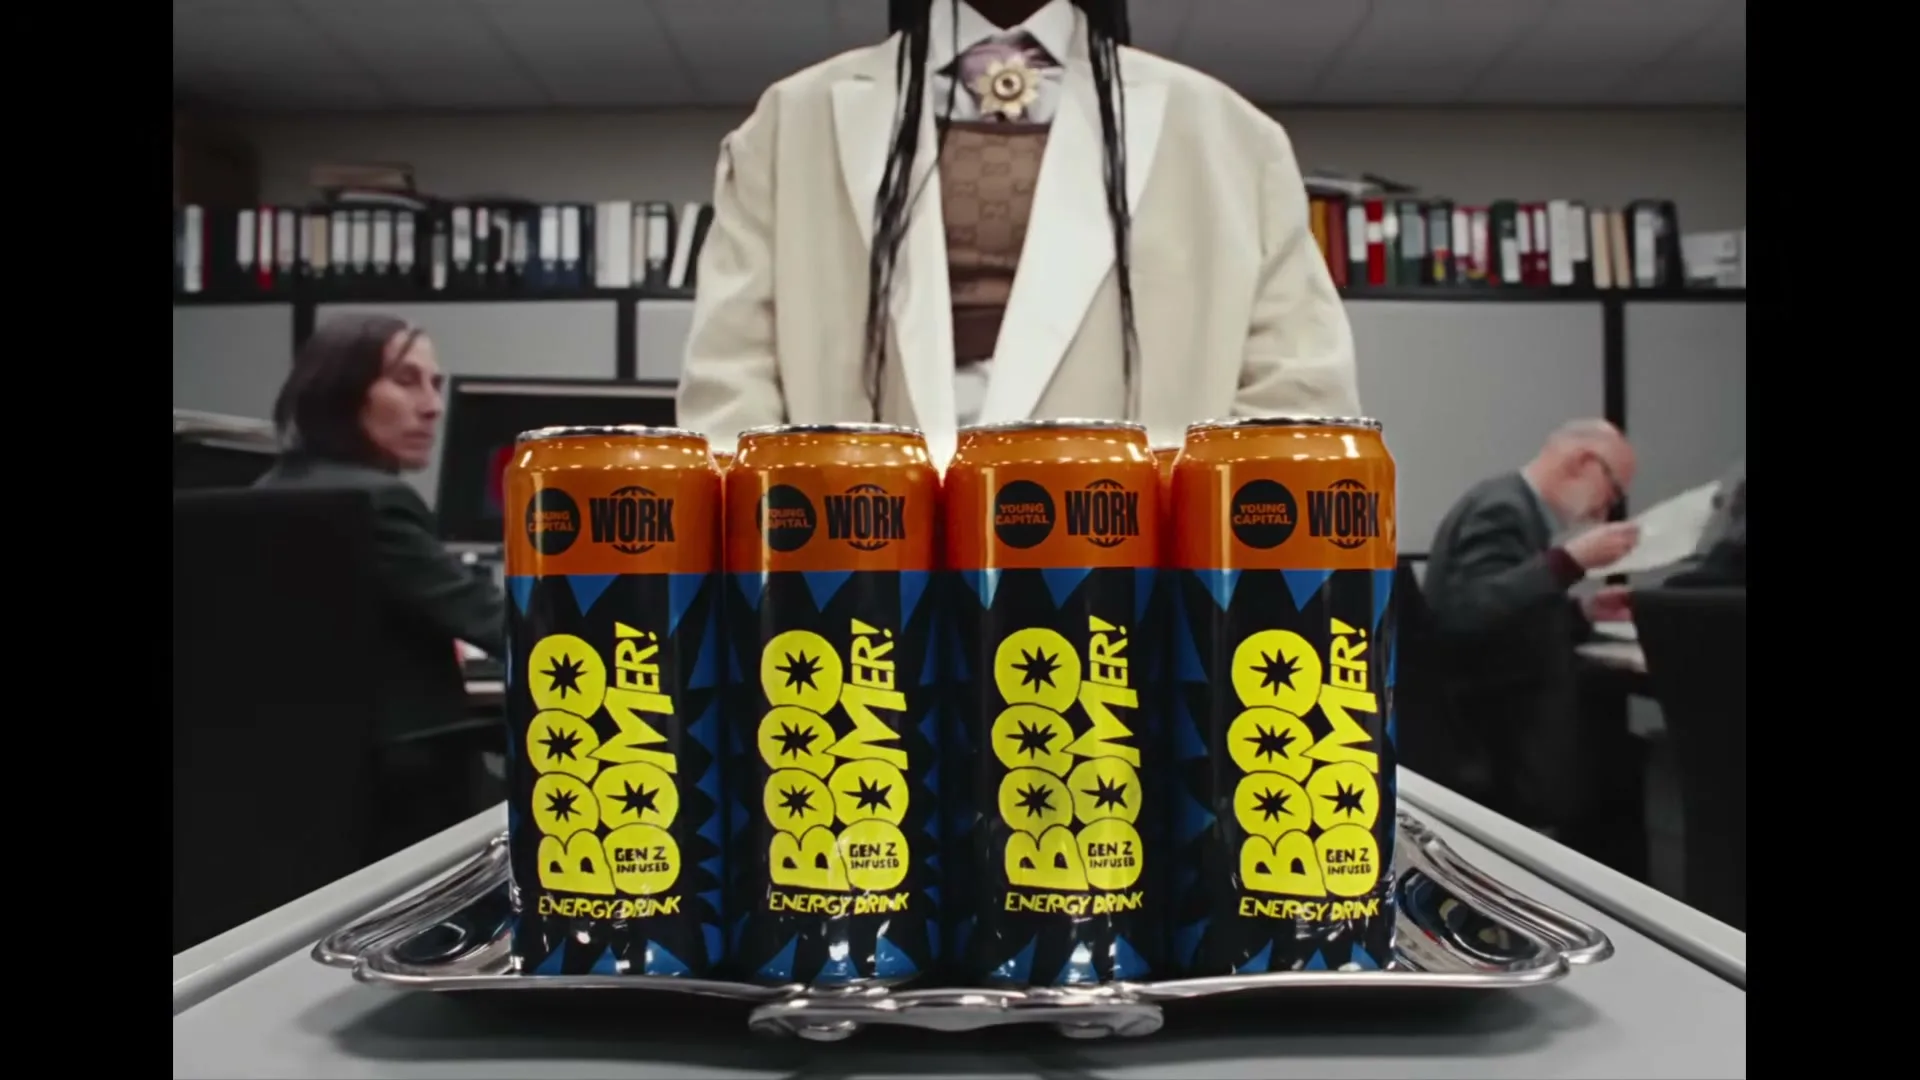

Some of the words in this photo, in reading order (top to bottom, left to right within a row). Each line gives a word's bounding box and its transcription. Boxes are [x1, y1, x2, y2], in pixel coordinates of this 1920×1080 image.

[999, 503, 1044, 513] YOUNG
[1065, 491, 1139, 536] WORK
[1239, 503, 1286, 513] YOUNG
[1306, 491, 1380, 537] WORK
[589, 497, 675, 543] WORK
[824, 495, 906, 540] WORK
[995, 514, 1049, 524] CAPITAL
[1234, 514, 1292, 525] CAPITAL
[615, 847, 648, 861] GEN
[653, 847, 667, 860] Z
[849, 844, 881, 857] GEN
[885, 843, 897, 857] Z
[1088, 843, 1118, 857] GEN
[1122, 841, 1134, 855] Z
[1326, 849, 1356, 863] GEN
[1359, 848, 1370, 862] Z
[616, 861, 670, 874] INFUSED
[851, 858, 900, 870] INFUSED
[1089, 857, 1136, 869] INFUSED
[1328, 863, 1372, 875] INFUSED
[538, 896, 617, 919] ENERGY
[622, 896, 681, 917] DRINK
[769, 892, 851, 918] ENERGY
[854, 892, 909, 915] DRINK
[1005, 892, 1088, 914] ENERGY
[1093, 891, 1143, 914] DRINK
[1239, 897, 1326, 919] ENERGY
[1331, 897, 1379, 921] DRINK
